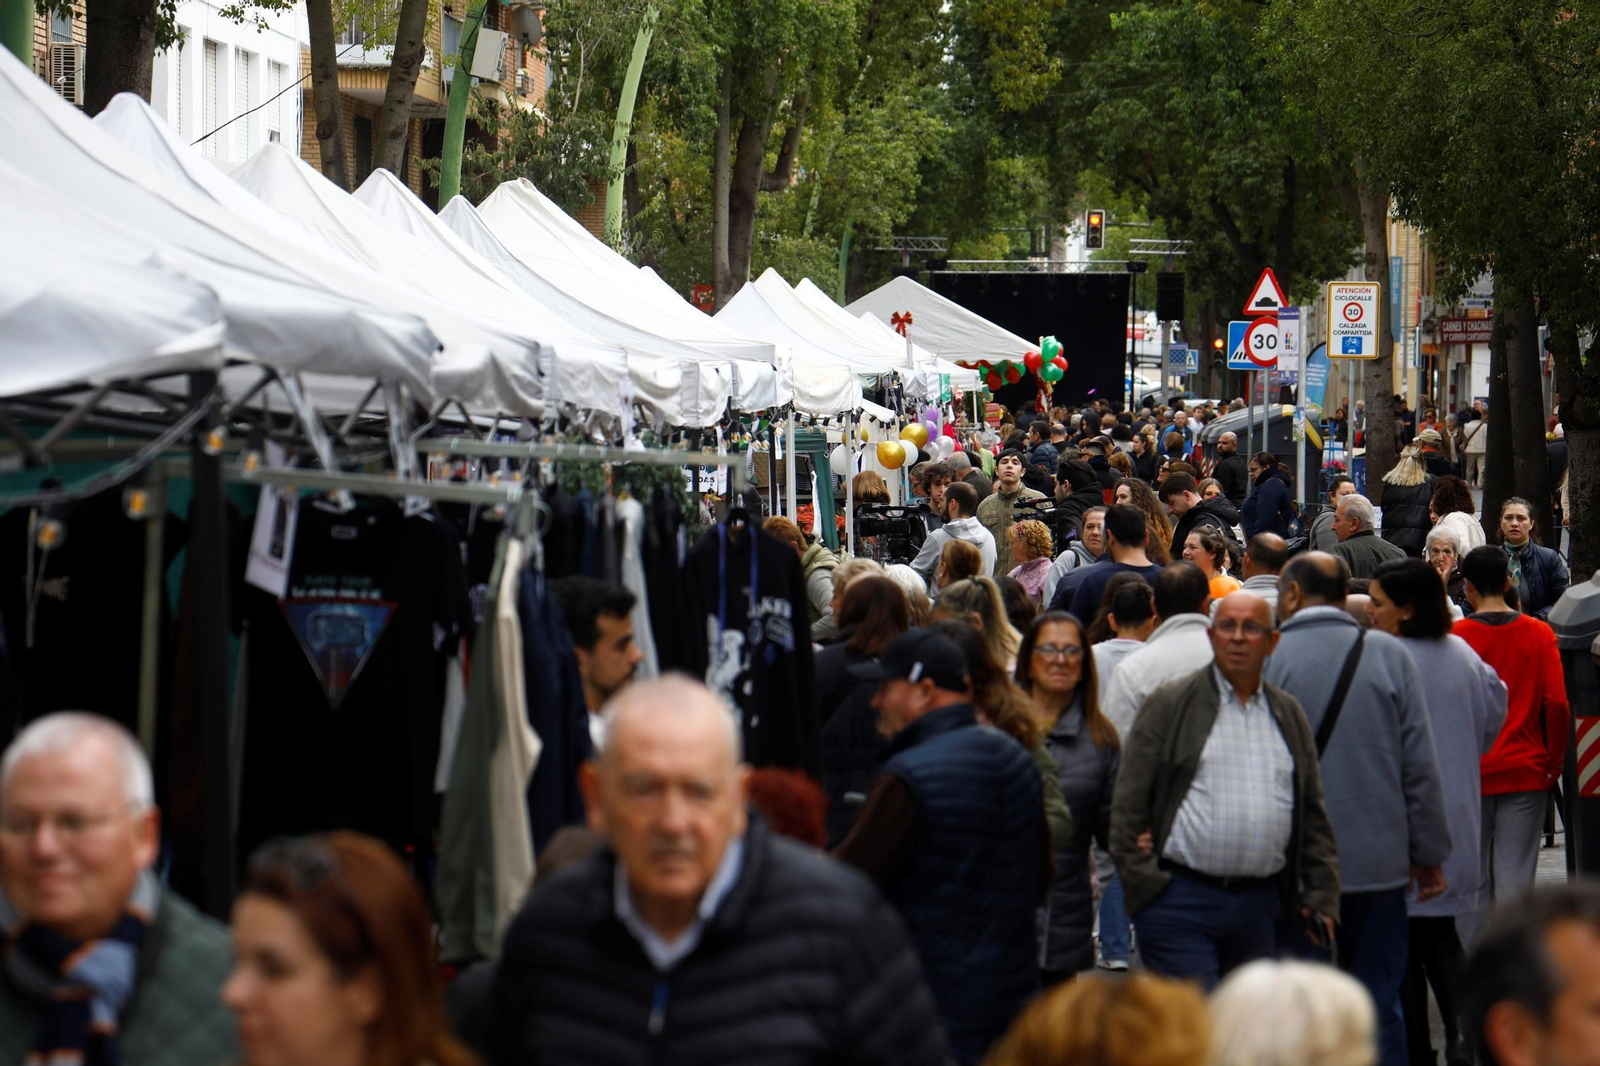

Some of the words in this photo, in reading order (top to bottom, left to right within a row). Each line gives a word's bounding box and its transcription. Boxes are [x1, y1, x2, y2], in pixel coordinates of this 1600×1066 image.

[1347, 308, 1359, 316] 30
[1442, 321, 1462, 332] CARNES
[1462, 321, 1467, 331] Y
[1467, 320, 1493, 331] CHACINAS
[1253, 334, 1278, 350] 30
